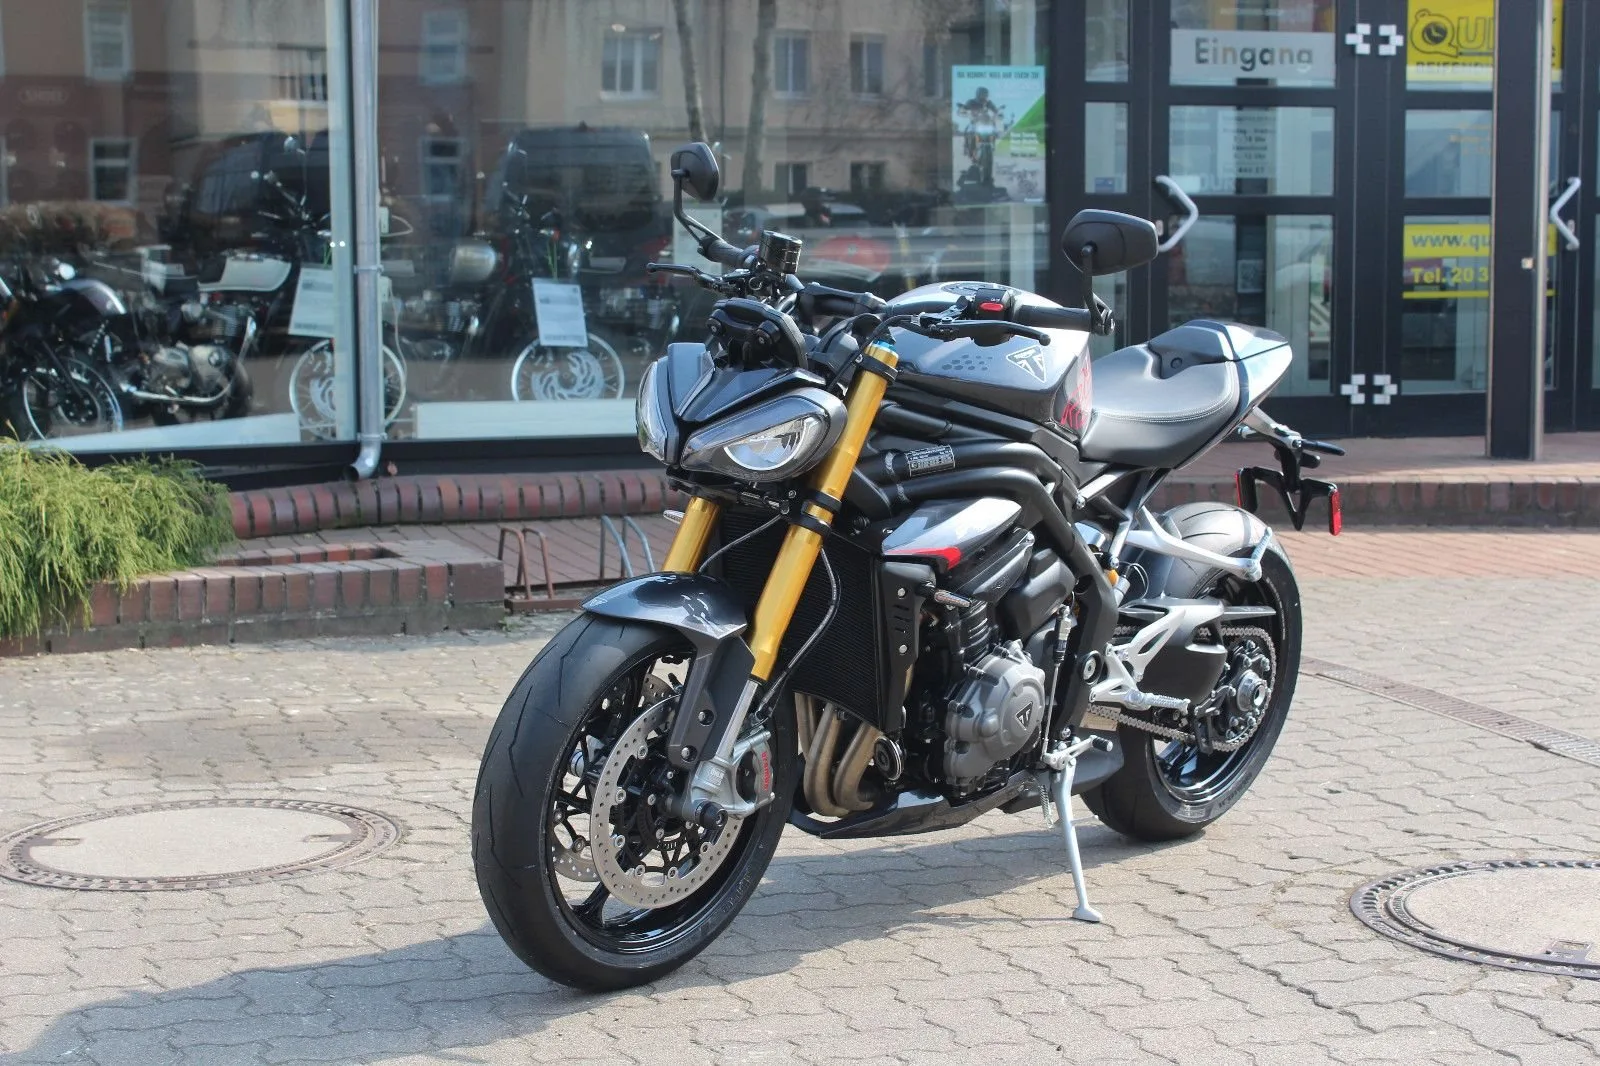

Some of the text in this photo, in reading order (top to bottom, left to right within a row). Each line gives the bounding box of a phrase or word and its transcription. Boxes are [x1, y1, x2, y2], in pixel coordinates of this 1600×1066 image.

[1195, 37, 1313, 72] Eingang
[1411, 266, 1490, 284] Tel. 20 3
